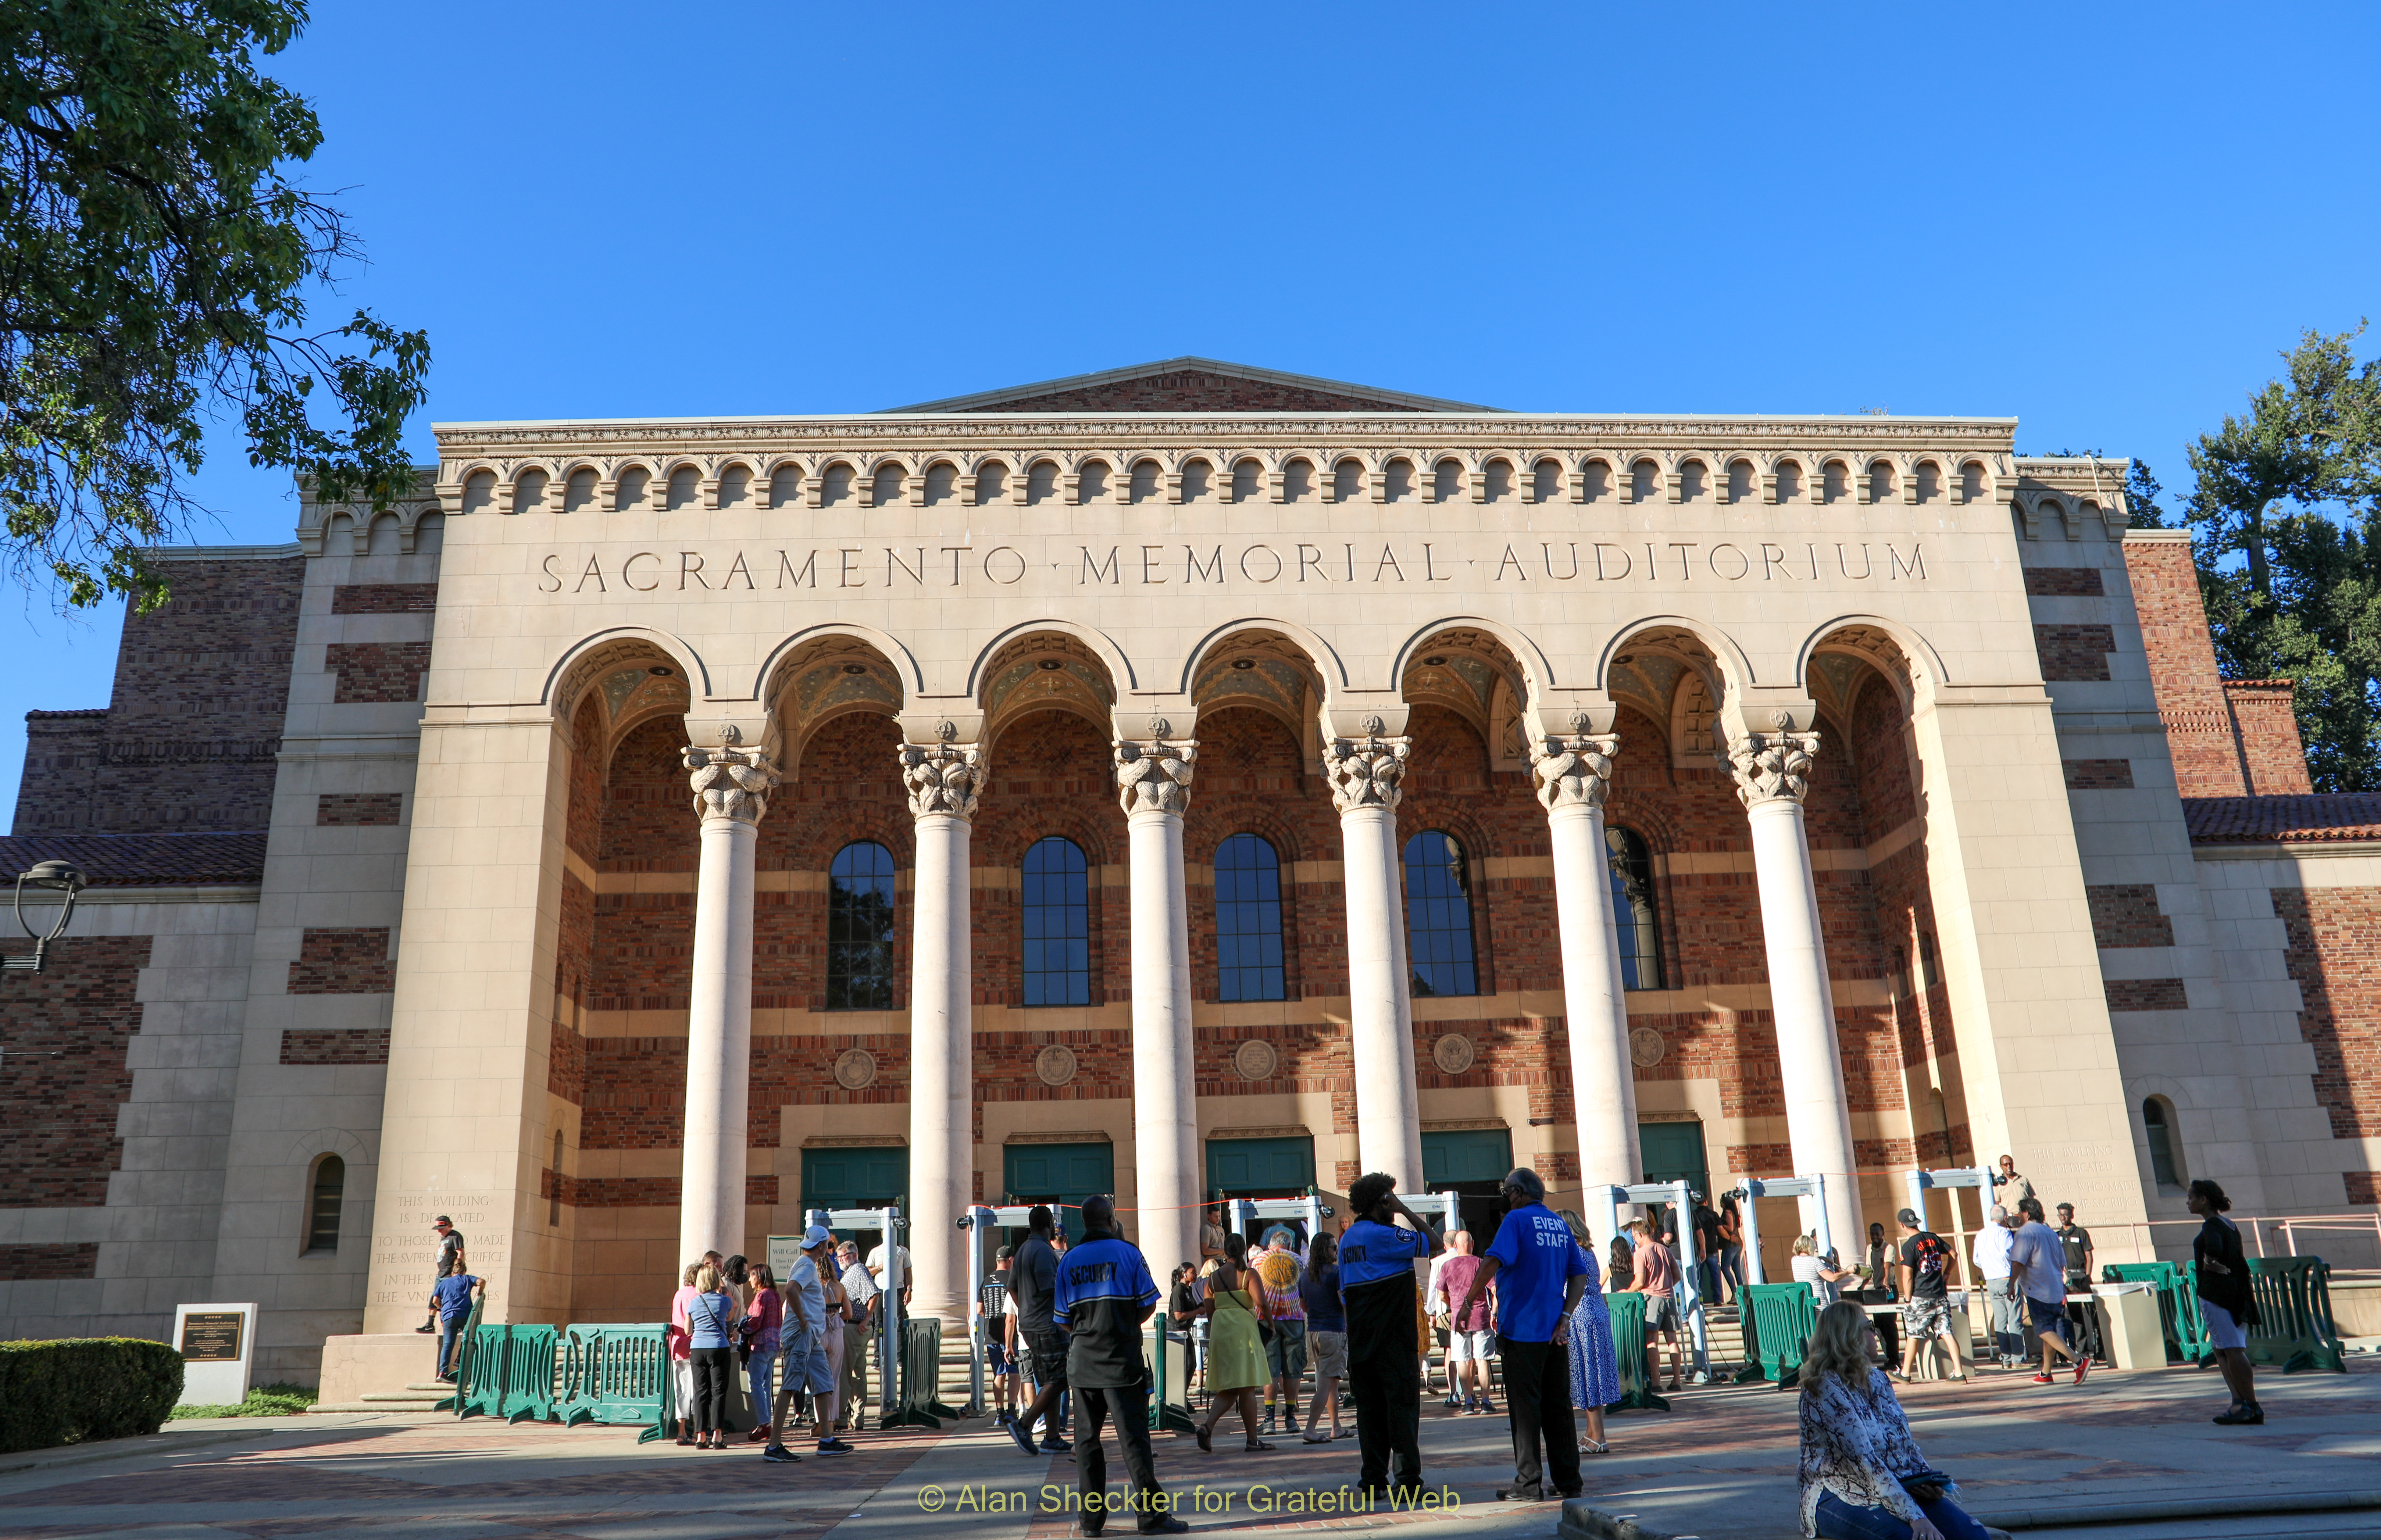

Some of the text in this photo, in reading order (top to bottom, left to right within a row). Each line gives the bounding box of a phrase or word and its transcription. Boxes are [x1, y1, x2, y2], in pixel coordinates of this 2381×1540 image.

[538, 541, 1931, 594] SACRAMENTO MEMORIAL AUDITORIUM
[2031, 1145, 2114, 1159] THIS BVILDING
[2037, 1161, 2114, 1175] IS DEDICATED
[2039, 1183, 2074, 1195] THOSE
[2077, 1182, 2104, 1193] WHO
[2108, 1180, 2139, 1192] MADE
[397, 1196, 489, 1207] THIS BVILDING
[2093, 1196, 2141, 1209] SACRIFICE
[400, 1213, 485, 1224] IS DECATED
[1532, 1216, 1566, 1232] EVENT
[377, 1236, 393, 1247] TO
[397, 1236, 435, 1246] THOSE
[473, 1234, 506, 1246] MADE
[1536, 1232, 1568, 1248] STAFF
[2110, 1232, 2146, 1246] STATS
[376, 1254, 397, 1265] THE
[464, 1251, 506, 1262] CRIFICE
[384, 1274, 397, 1285] IN
[401, 1274, 424, 1285] THE
[1069, 1262, 1118, 1287] SECURITY
[375, 1292, 398, 1303] THE
